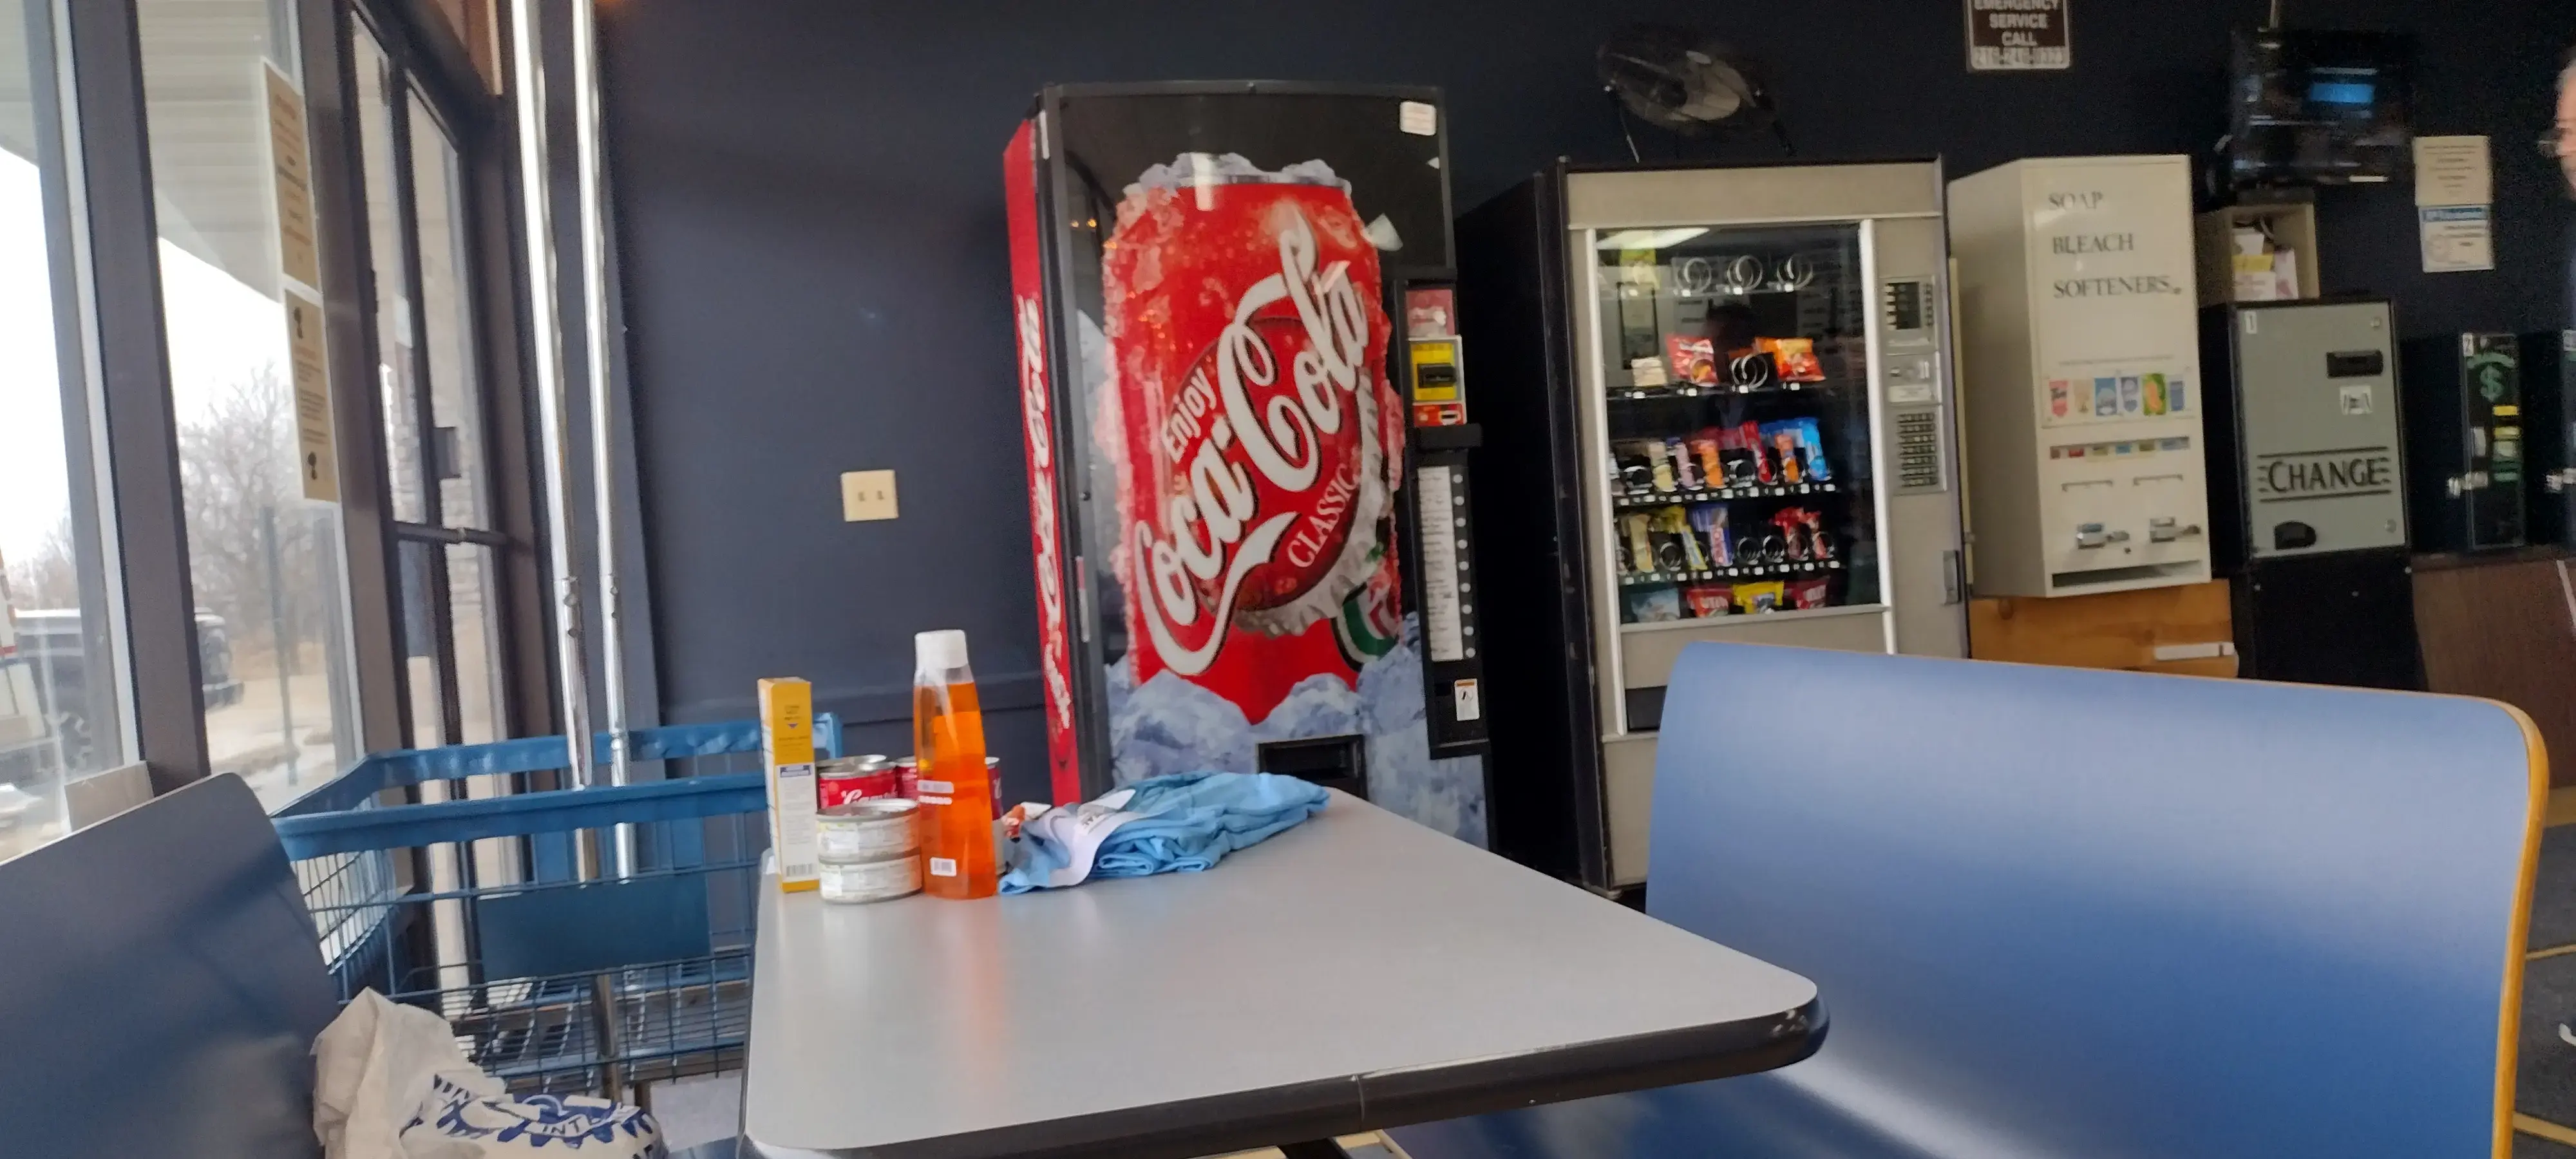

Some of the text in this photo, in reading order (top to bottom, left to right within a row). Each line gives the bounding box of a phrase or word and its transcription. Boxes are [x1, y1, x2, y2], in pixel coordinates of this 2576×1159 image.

[1989, 13, 2049, 29] SERVICE
[2002, 31, 2038, 46] CALL
[2048, 191, 2104, 211] SOAP
[2052, 232, 2134, 255] BLEACH
[1161, 367, 1217, 463] Enjoy
[2268, 458, 2382, 495] CHANGE
[1289, 464, 1356, 568] CLASSIC
